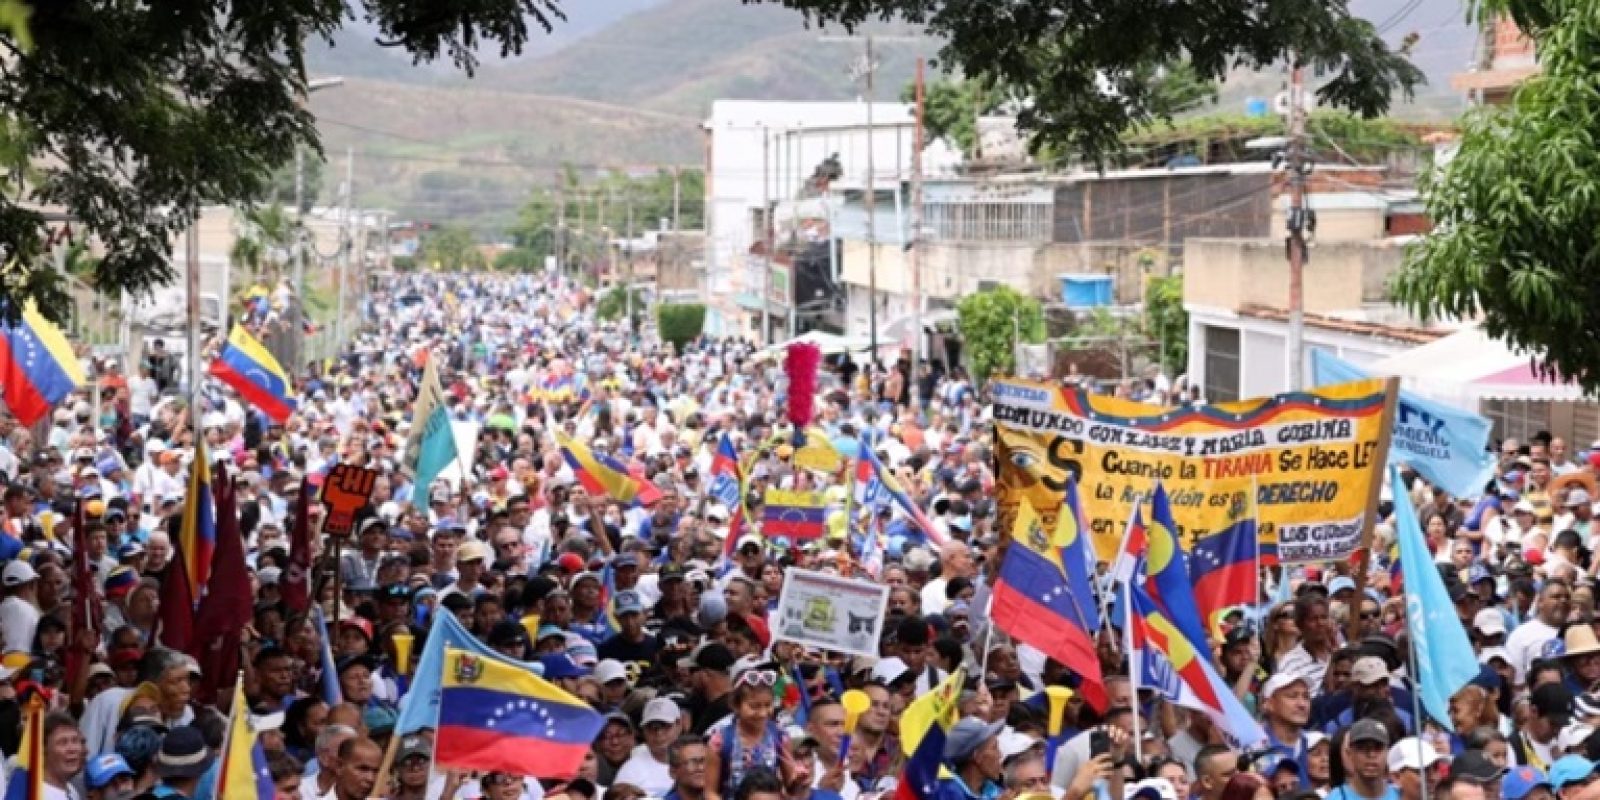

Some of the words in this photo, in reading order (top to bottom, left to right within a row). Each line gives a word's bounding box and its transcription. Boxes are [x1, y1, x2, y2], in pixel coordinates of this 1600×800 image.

[993, 404, 1084, 434] EDMUNDO
[1184, 437, 1197, 457] Y
[1277, 418, 1351, 443] CORINA
[1102, 451, 1173, 478] Cuando
[1279, 449, 1302, 471] Se
[1307, 446, 1349, 469] Hace
[1257, 480, 1338, 505] DERECHO
